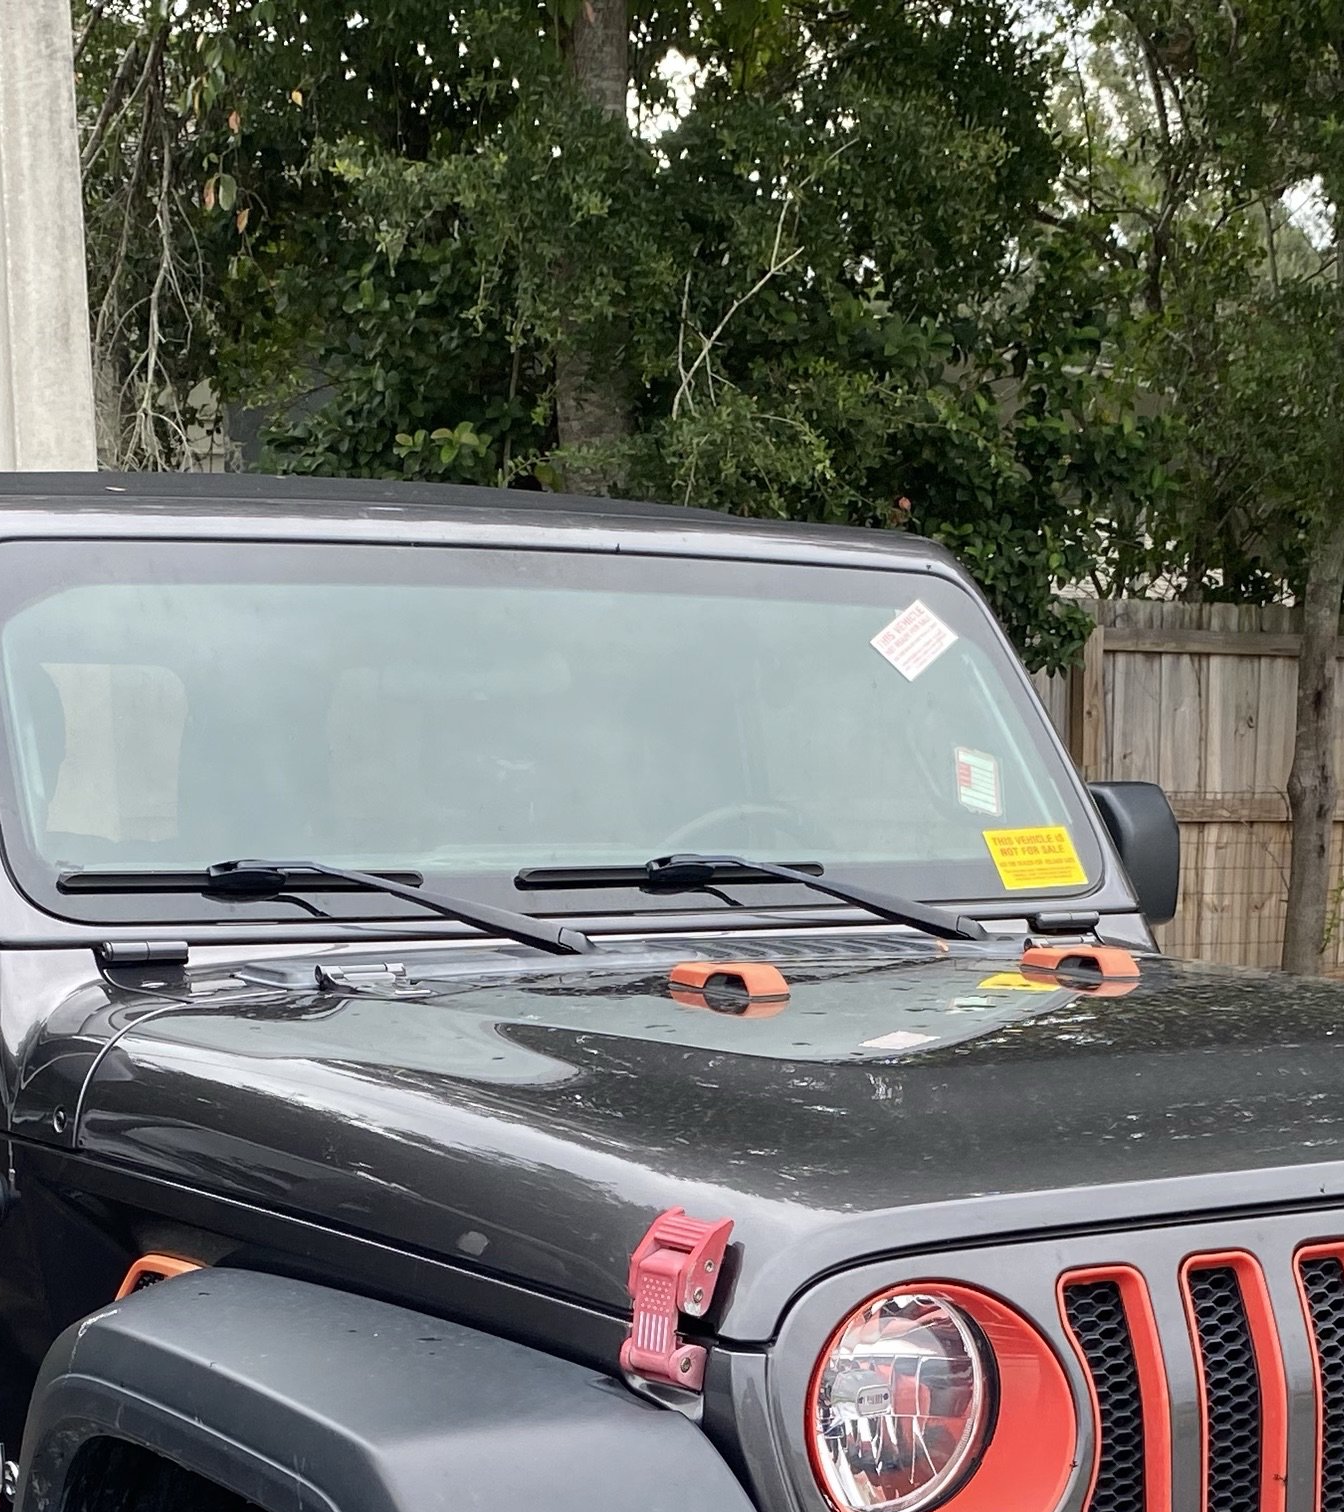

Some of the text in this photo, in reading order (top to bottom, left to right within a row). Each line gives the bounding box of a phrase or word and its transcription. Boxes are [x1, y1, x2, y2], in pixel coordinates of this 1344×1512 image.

[876, 631, 896, 650] THIS
[892, 605, 925, 635] VEHICLE
[992, 836, 1014, 846] THIS
[1015, 834, 1053, 845] VEHICLE
[1000, 844, 1065, 857] NOT FOR SALE
